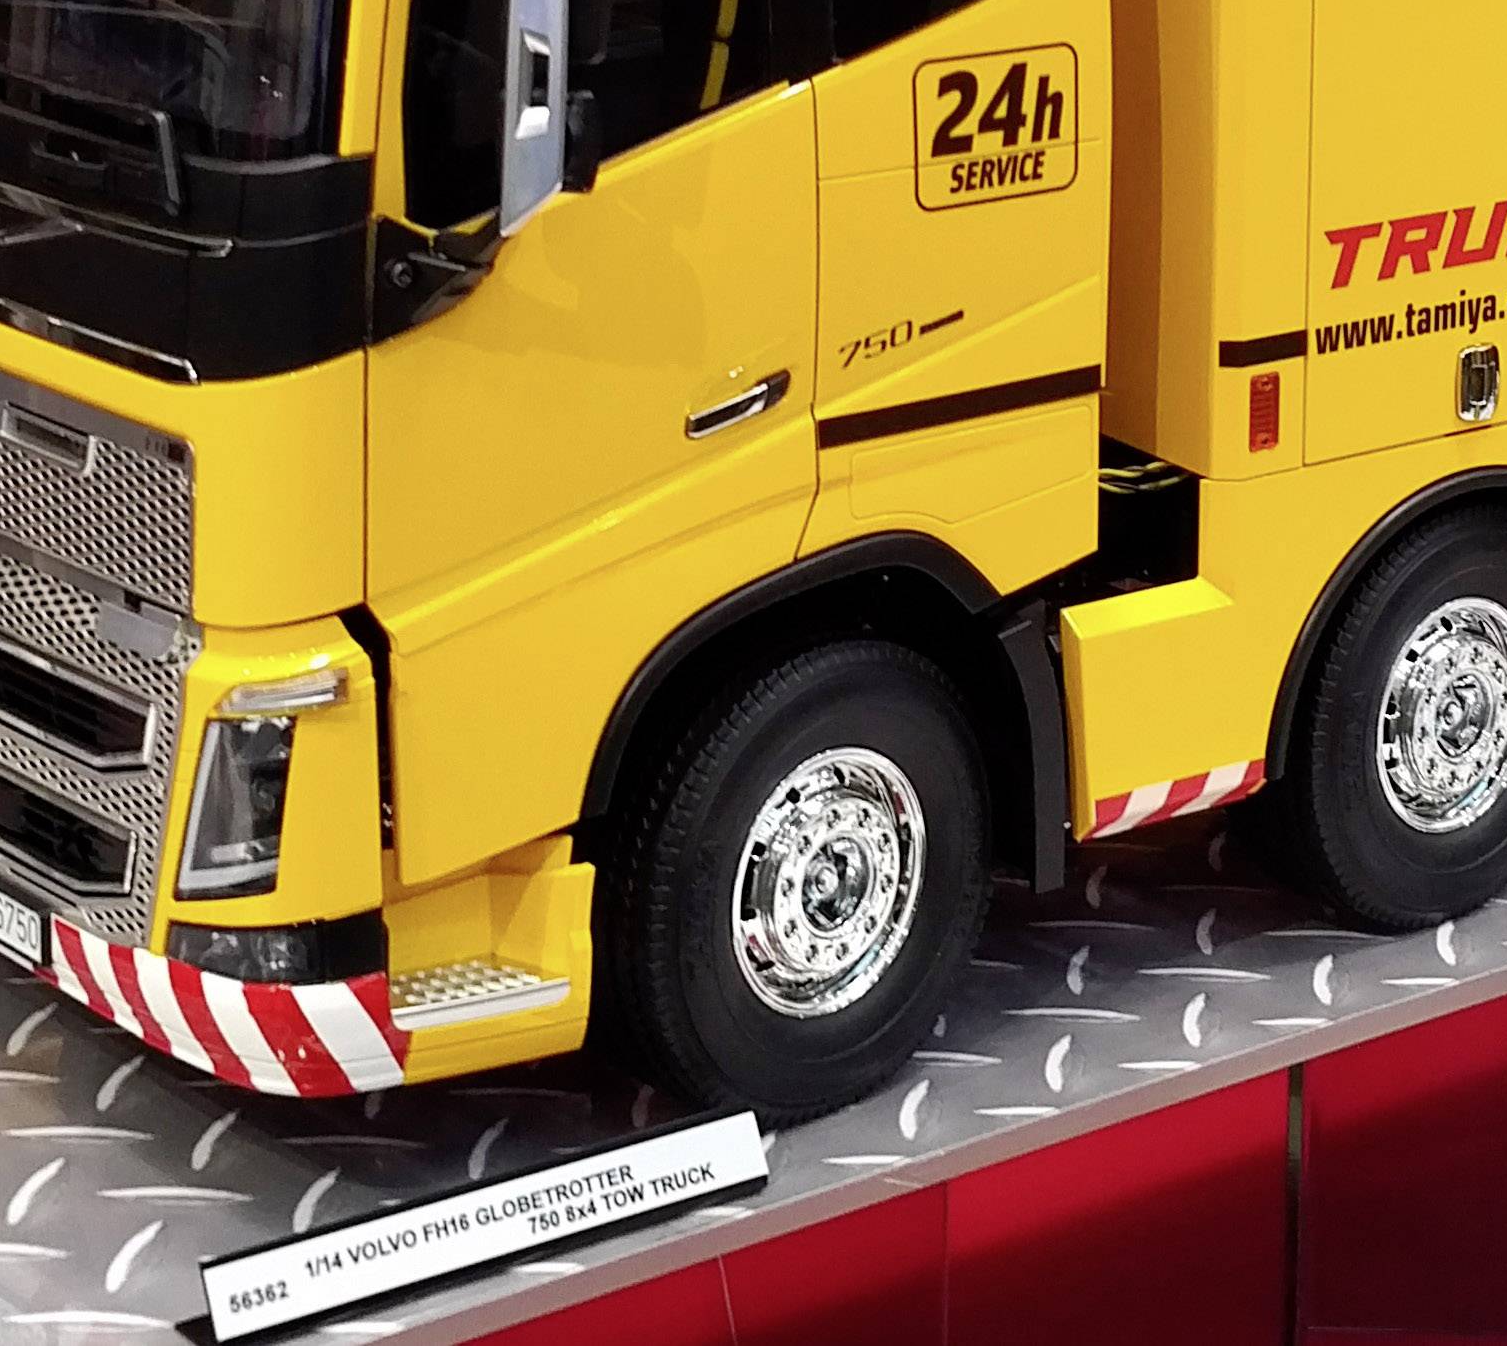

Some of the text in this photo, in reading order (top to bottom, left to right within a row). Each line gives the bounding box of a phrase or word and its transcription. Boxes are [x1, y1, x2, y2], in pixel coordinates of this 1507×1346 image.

[932, 62, 1064, 158] 24h
[950, 151, 1046, 194] SERVICE
[838, 320, 913, 369] 750
[528, 1162, 716, 1236] 750 8x4 TOW TRUCK
[228, 1164, 635, 1314] 56362 1/14 VOLVO FH16 GLOBETROTTER
